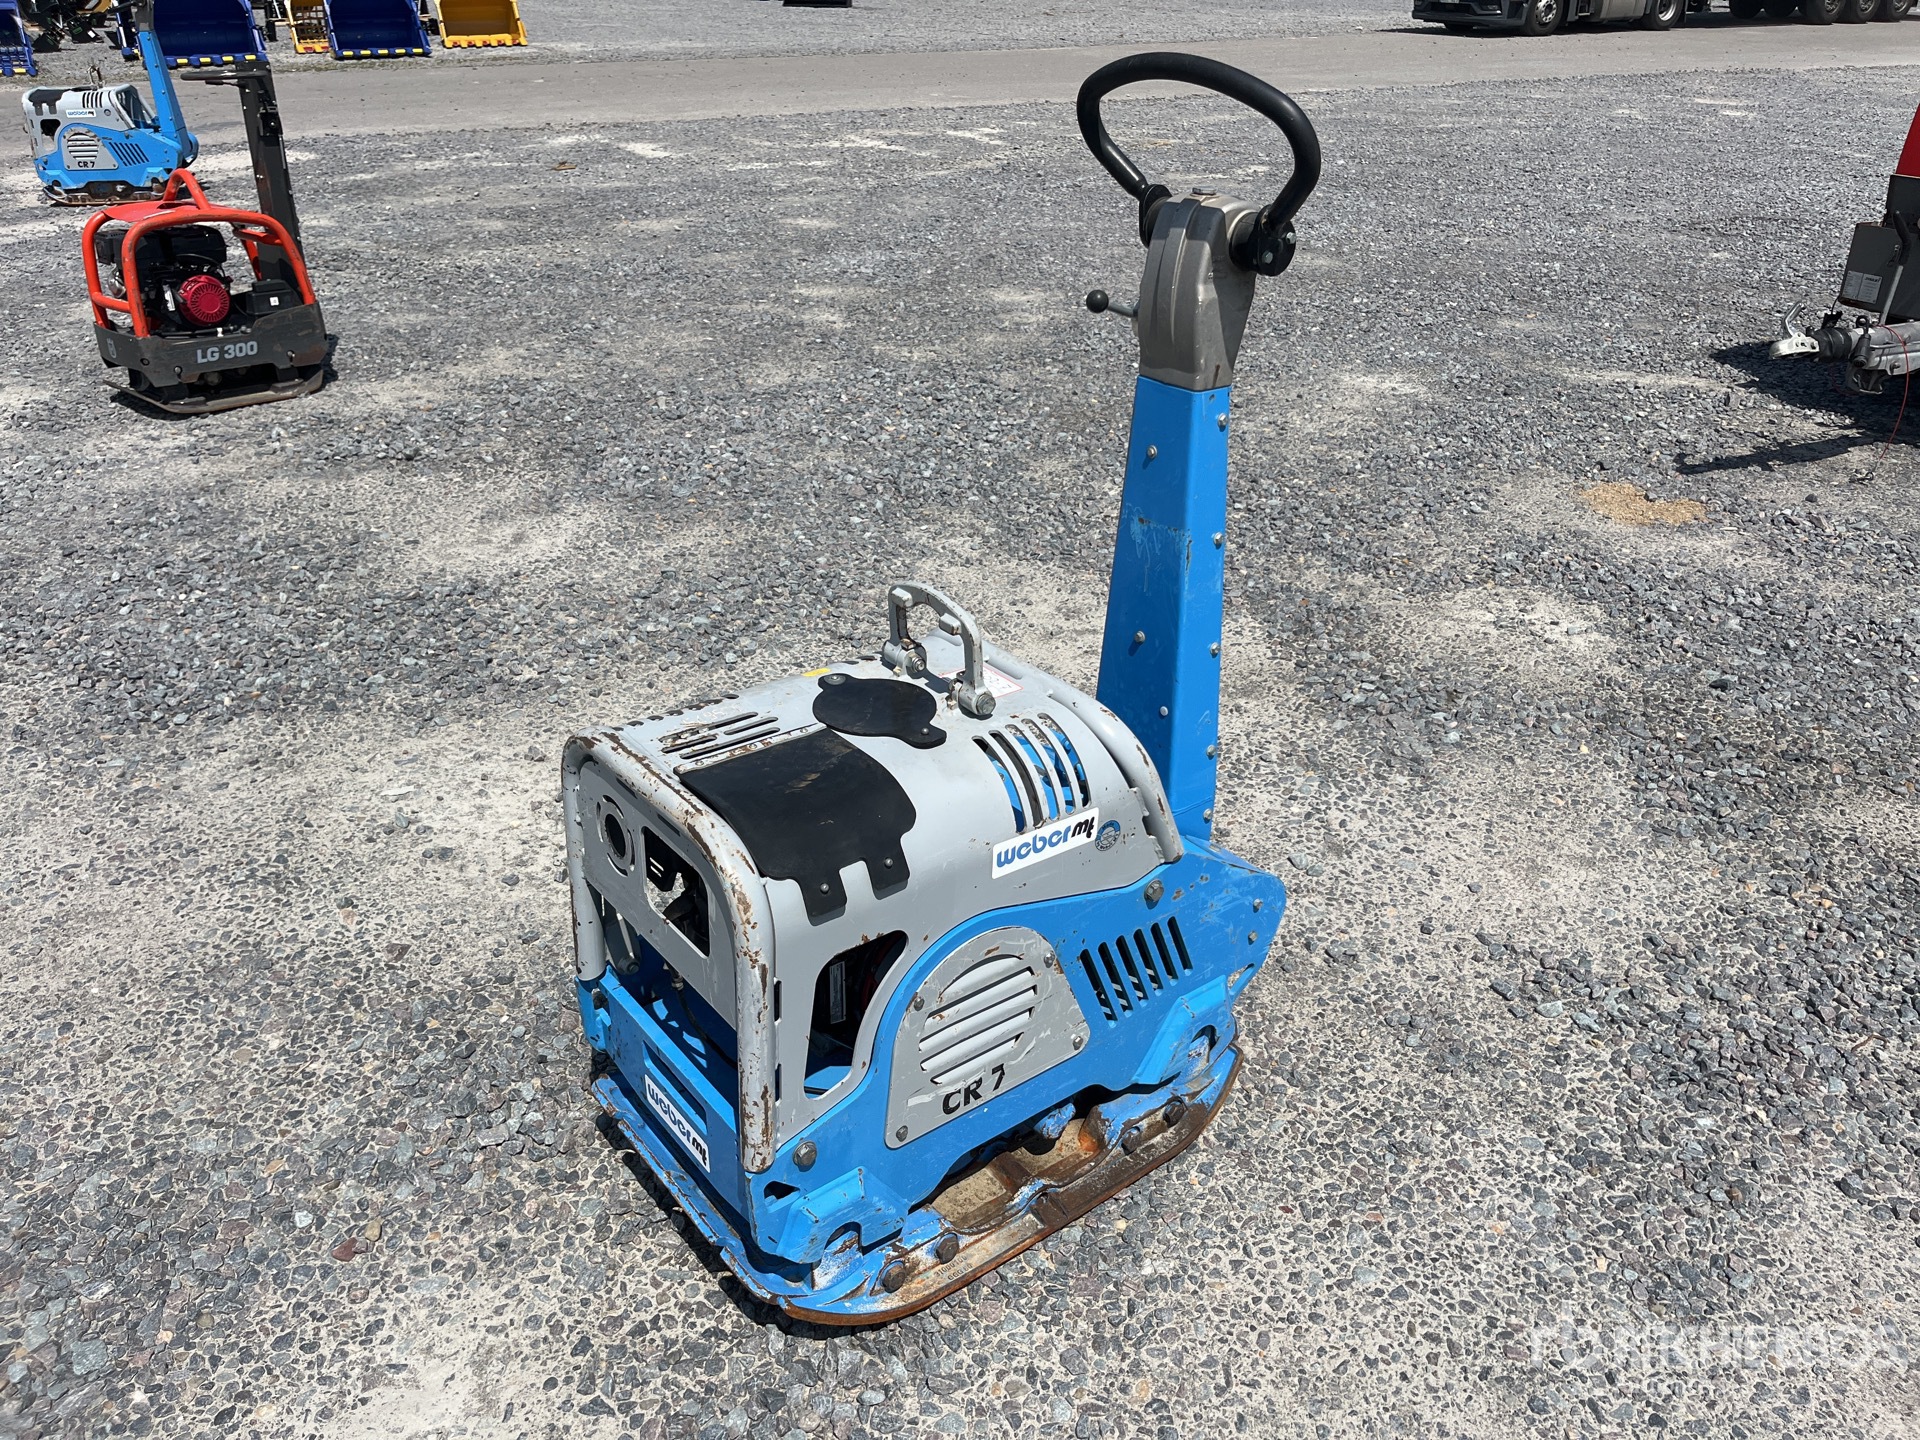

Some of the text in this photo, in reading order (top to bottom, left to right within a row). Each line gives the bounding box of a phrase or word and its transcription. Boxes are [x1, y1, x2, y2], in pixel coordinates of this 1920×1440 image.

[196, 340, 258, 364] LG 300
[942, 1063, 1006, 1115] CR 7
